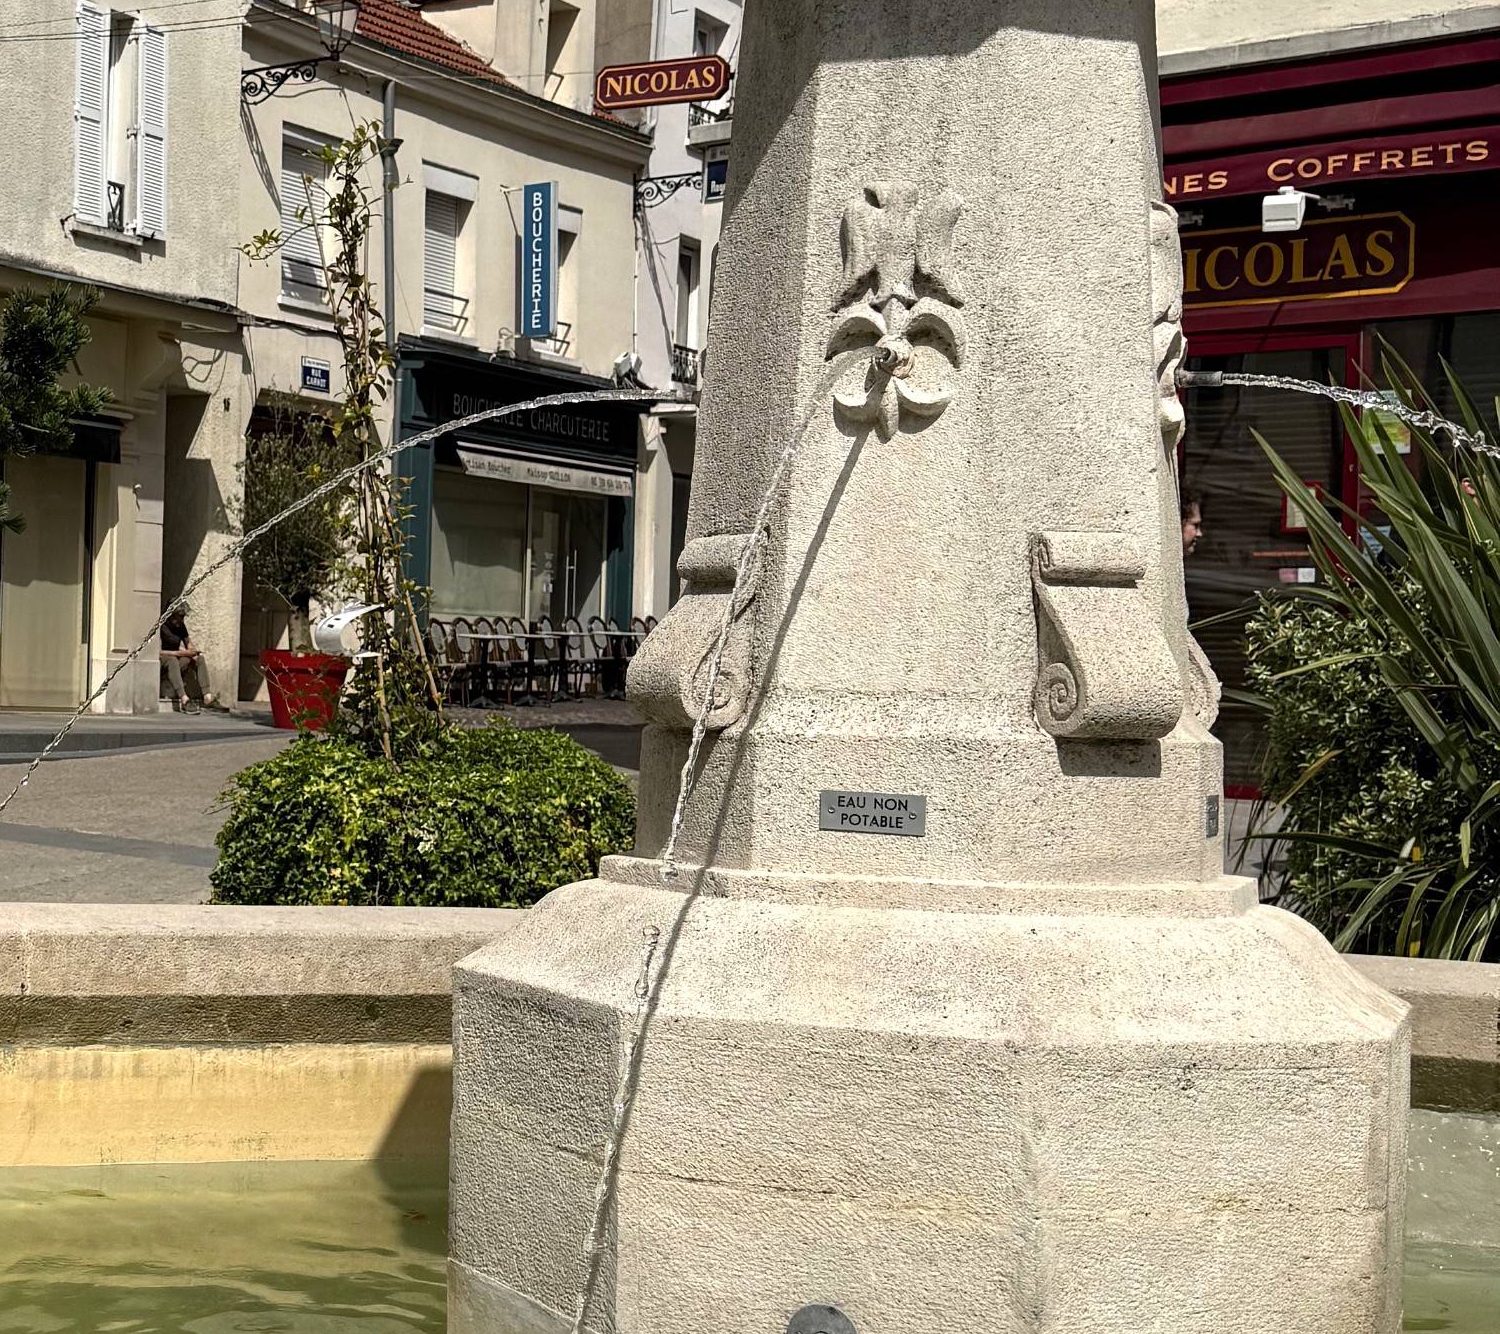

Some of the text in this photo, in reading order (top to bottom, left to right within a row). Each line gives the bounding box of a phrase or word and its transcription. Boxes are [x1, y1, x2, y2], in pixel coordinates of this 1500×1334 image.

[605, 66, 716, 98] NICOLAS
[1267, 140, 1489, 182] COFFRETS
[532, 192, 543, 329] BOUCHERIE
[1183, 229, 1395, 294] ICOLAS
[530, 409, 609, 442] CHARCUTERIE
[837, 795, 908, 811] EAU NON
[841, 813, 904, 828] POTABLE
